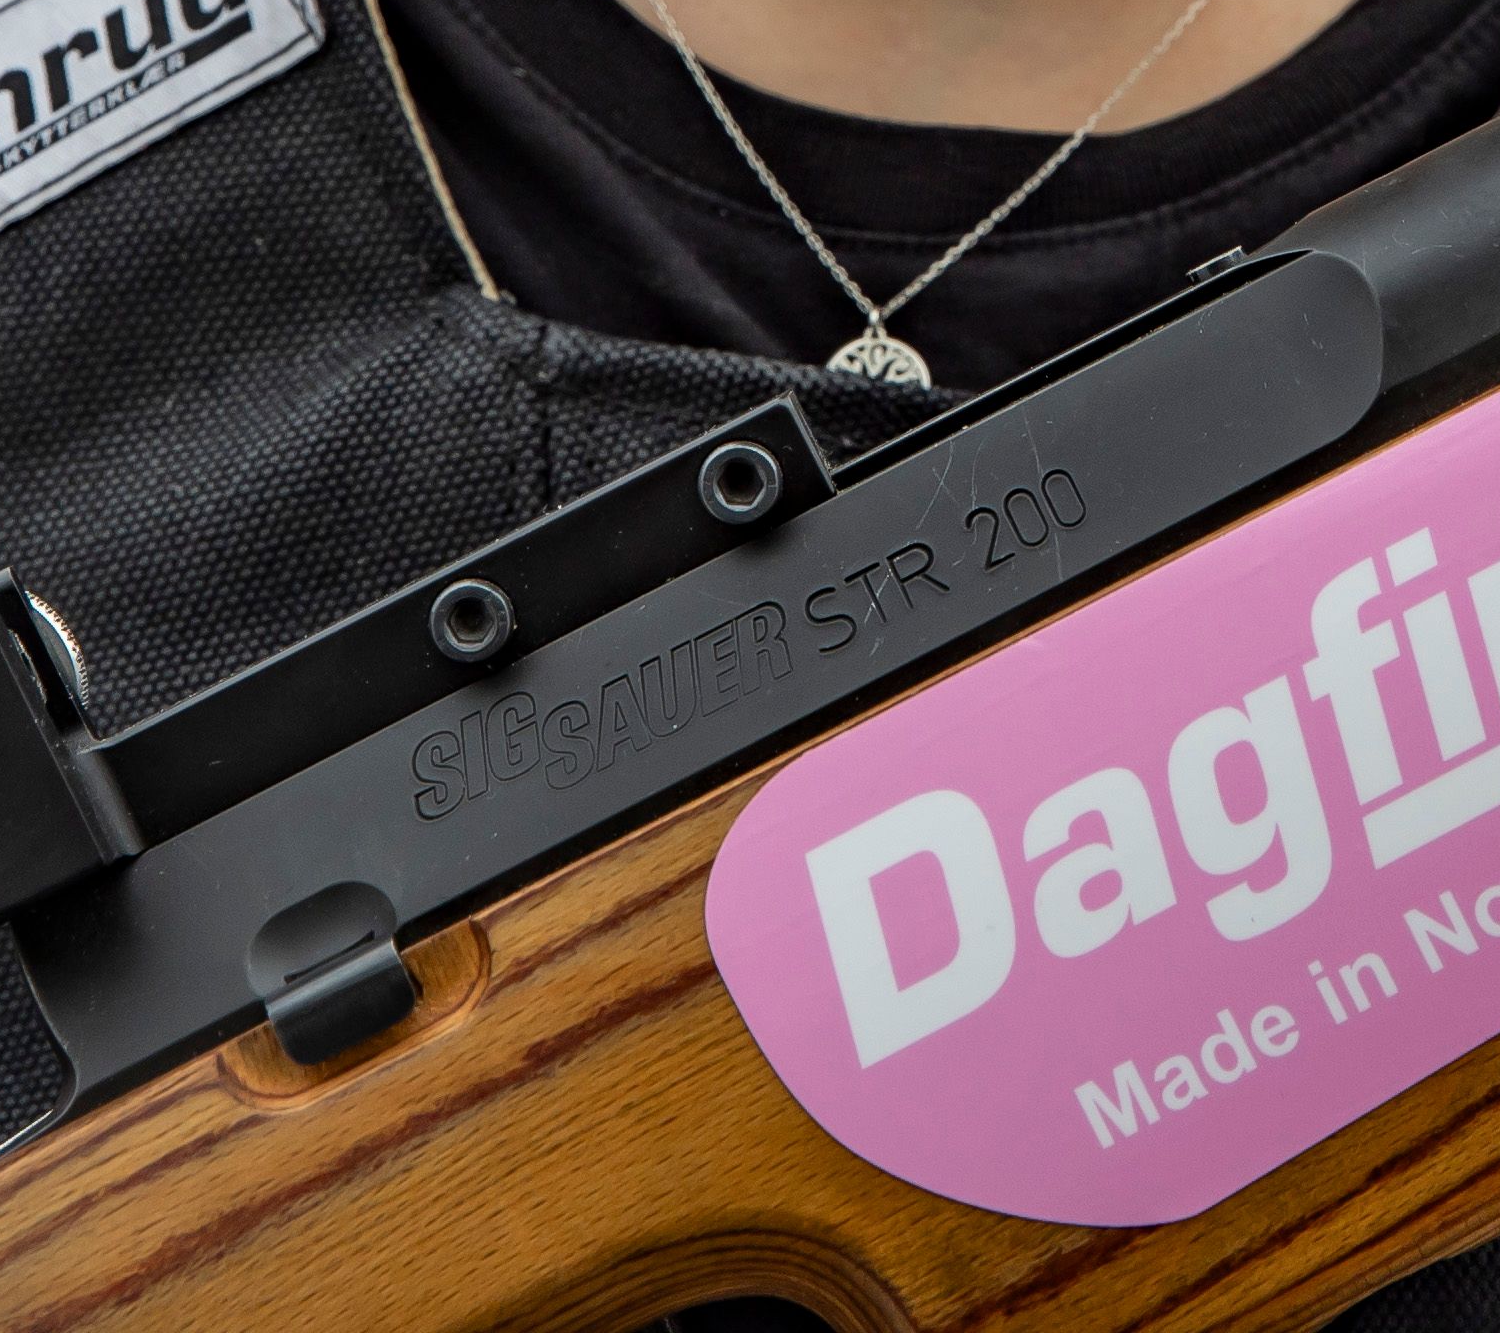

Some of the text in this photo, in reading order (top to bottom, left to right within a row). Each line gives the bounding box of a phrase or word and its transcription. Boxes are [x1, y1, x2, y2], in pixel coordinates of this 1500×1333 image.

[804, 541, 950, 655] STR
[964, 468, 1088, 575] 200
[1072, 997, 1301, 1150] Made
[1307, 947, 1400, 1027] in
